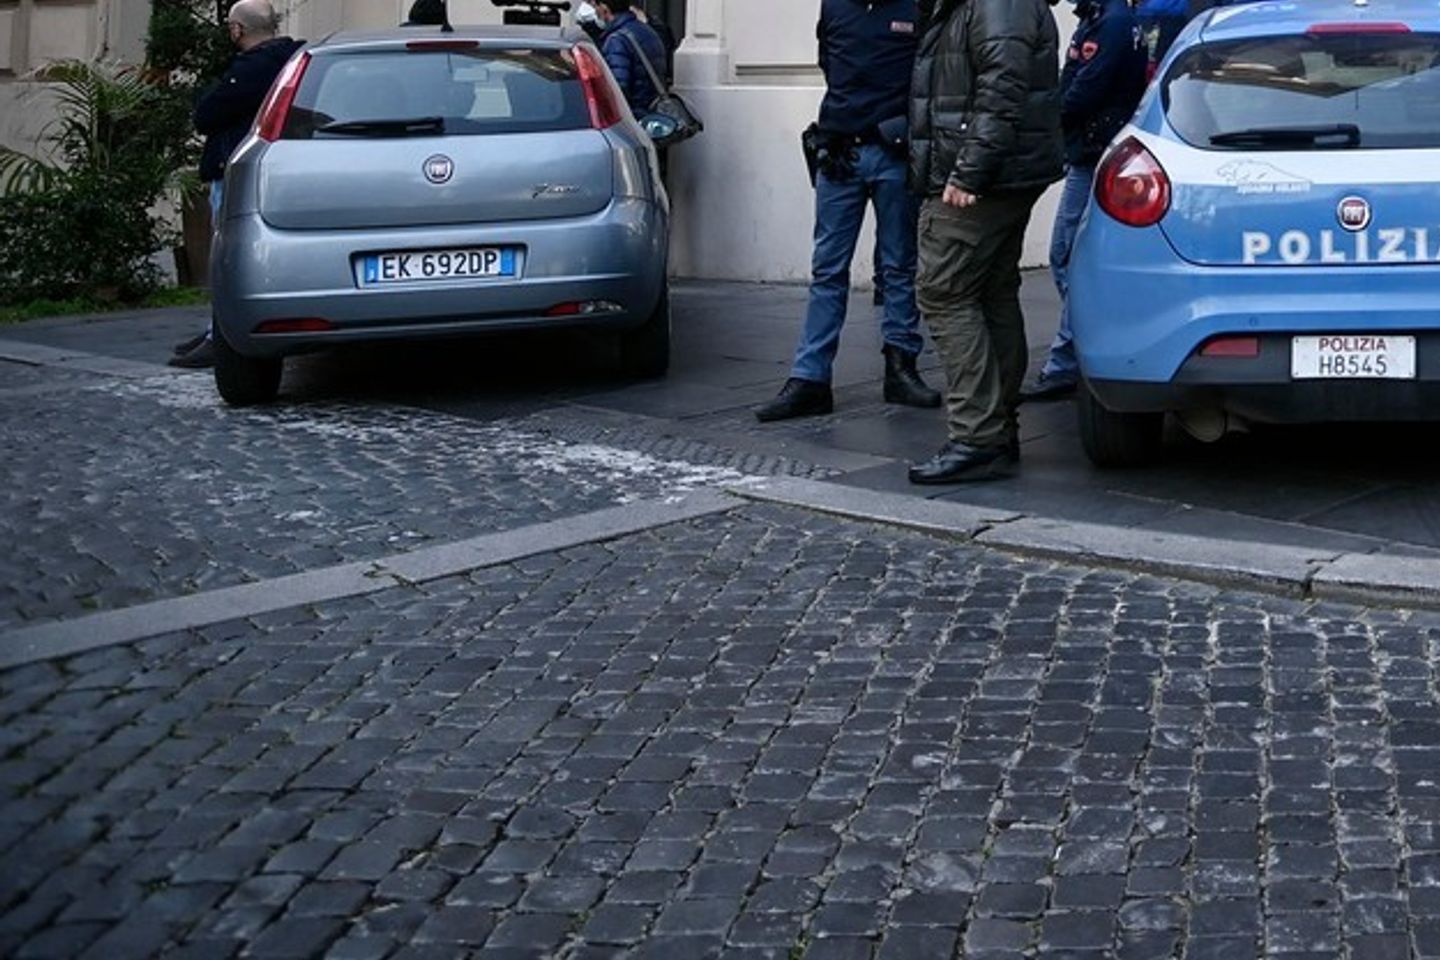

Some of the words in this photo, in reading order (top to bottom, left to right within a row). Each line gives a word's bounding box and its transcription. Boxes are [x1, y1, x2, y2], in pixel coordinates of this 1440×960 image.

[381, 255, 412, 280] EK
[421, 250, 498, 277] 692DP
[1318, 337, 1387, 352] POLIZIA
[1318, 354, 1388, 376] H8545
